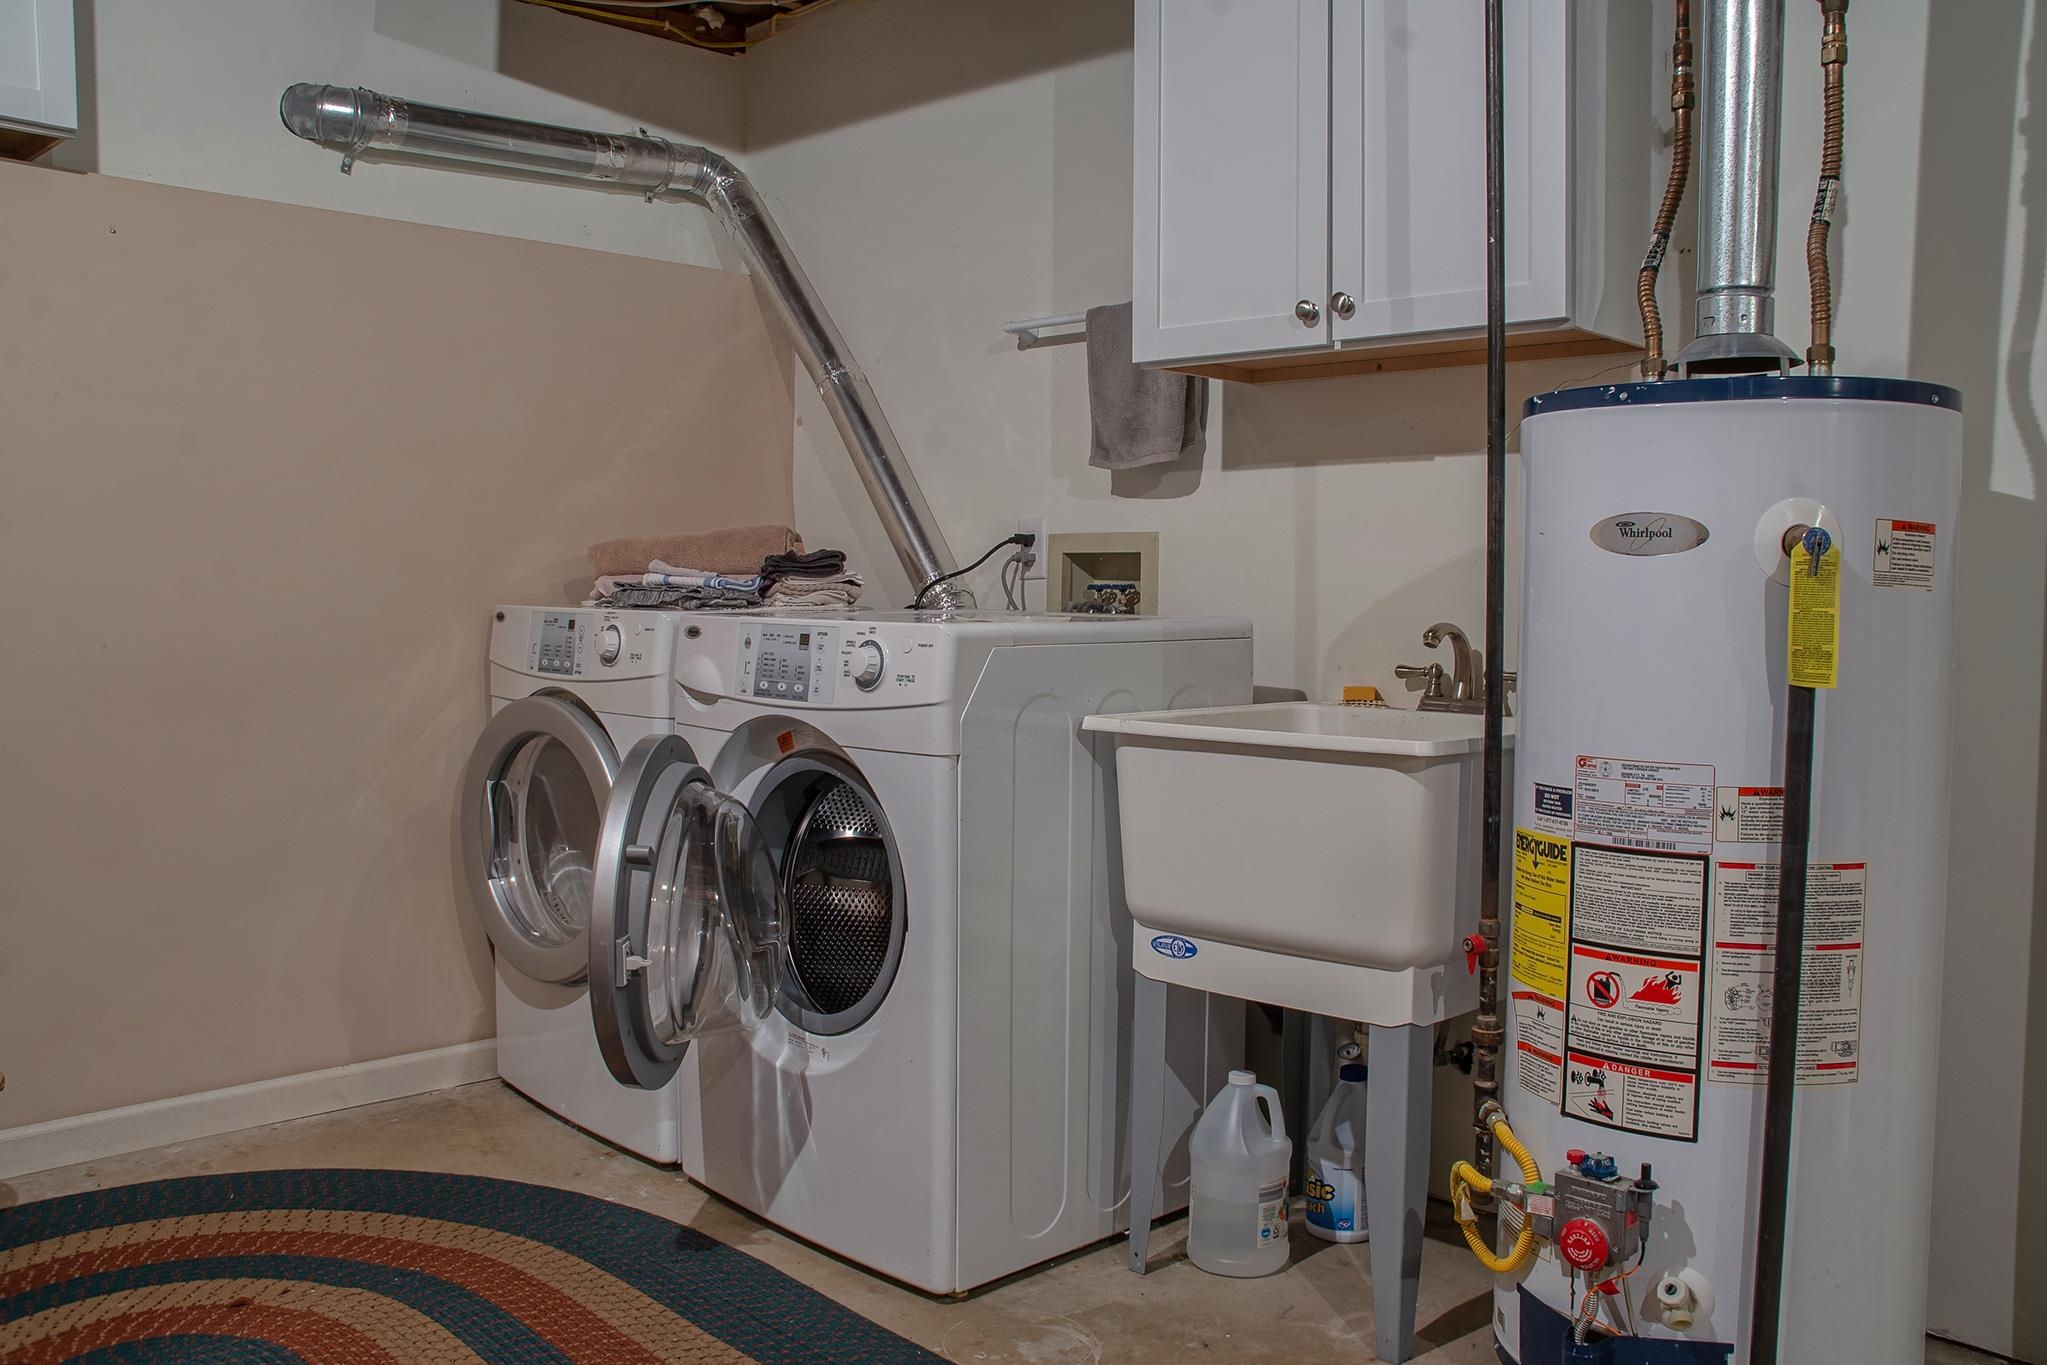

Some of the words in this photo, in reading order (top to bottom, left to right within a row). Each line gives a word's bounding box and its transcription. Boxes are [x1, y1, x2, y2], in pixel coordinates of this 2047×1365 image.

[1619, 528, 1672, 540] Whirlpool
[1611, 954, 1656, 967] WARNING
[1611, 1064, 1651, 1077] DANGER
